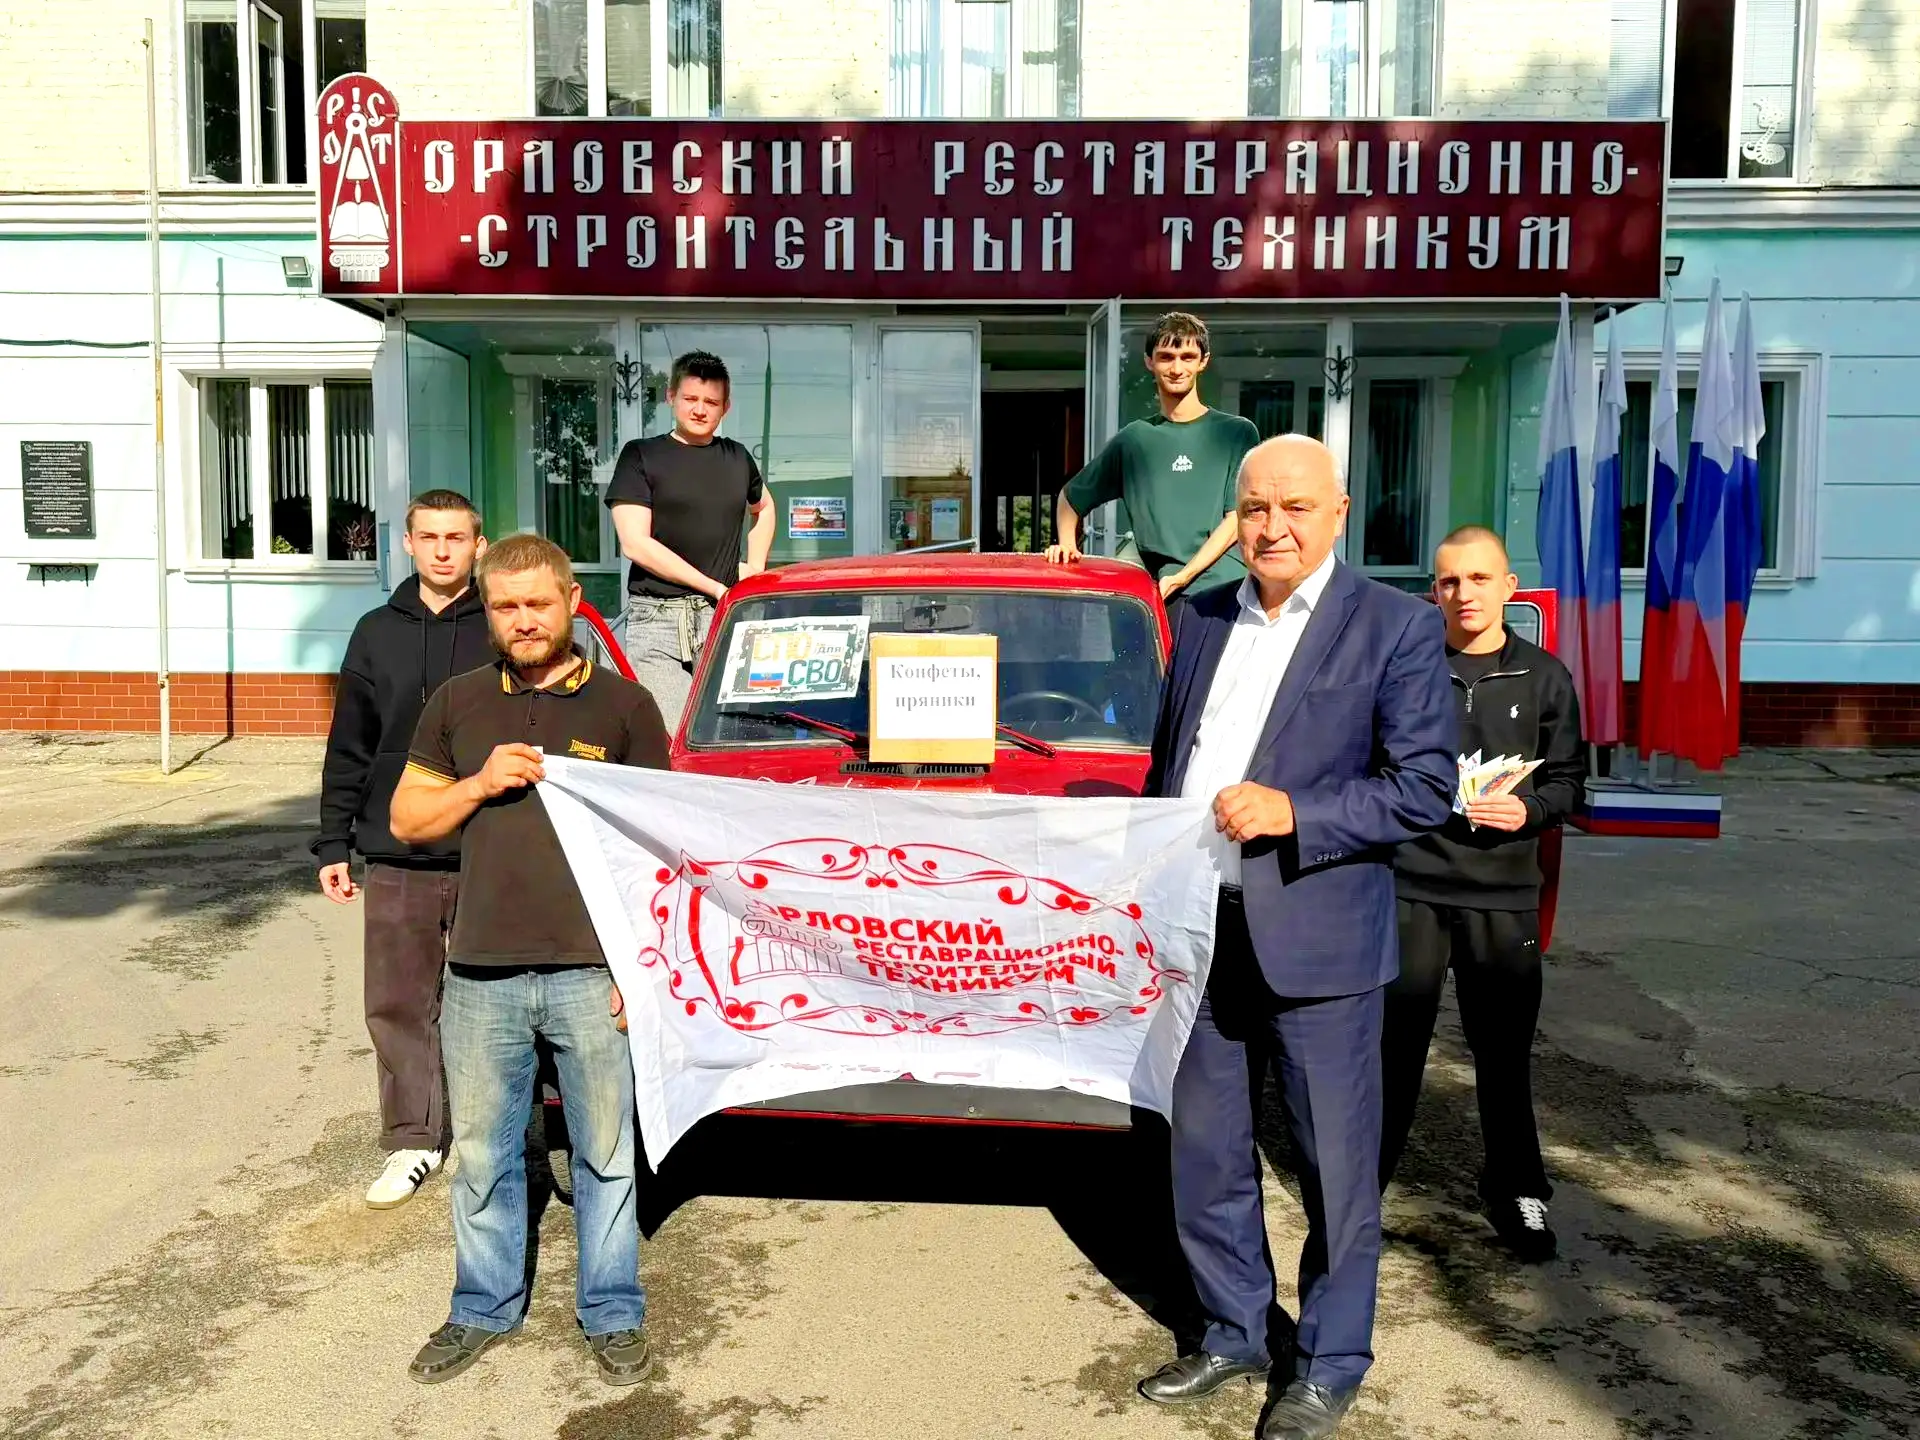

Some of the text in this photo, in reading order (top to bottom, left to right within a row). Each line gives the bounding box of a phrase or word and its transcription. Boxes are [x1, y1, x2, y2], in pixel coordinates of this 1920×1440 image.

[424, 136, 1638, 198] ОРЛОВСКИЙ РЕСТАВРАЦИОННО-
[460, 211, 1571, 271] -СТРОИТЕЛЬНЫЙ ТЕХНИКУМ
[788, 658, 843, 686] СВО
[891, 664, 981, 683] Конфеты,
[896, 695, 976, 711] пряники
[853, 934, 1124, 962] РЕСТАВРАЦИОННО-
[856, 953, 1116, 979] ОИТЕЛЬНЫЙ
[859, 960, 1074, 993] ТЕХНИКУМ
